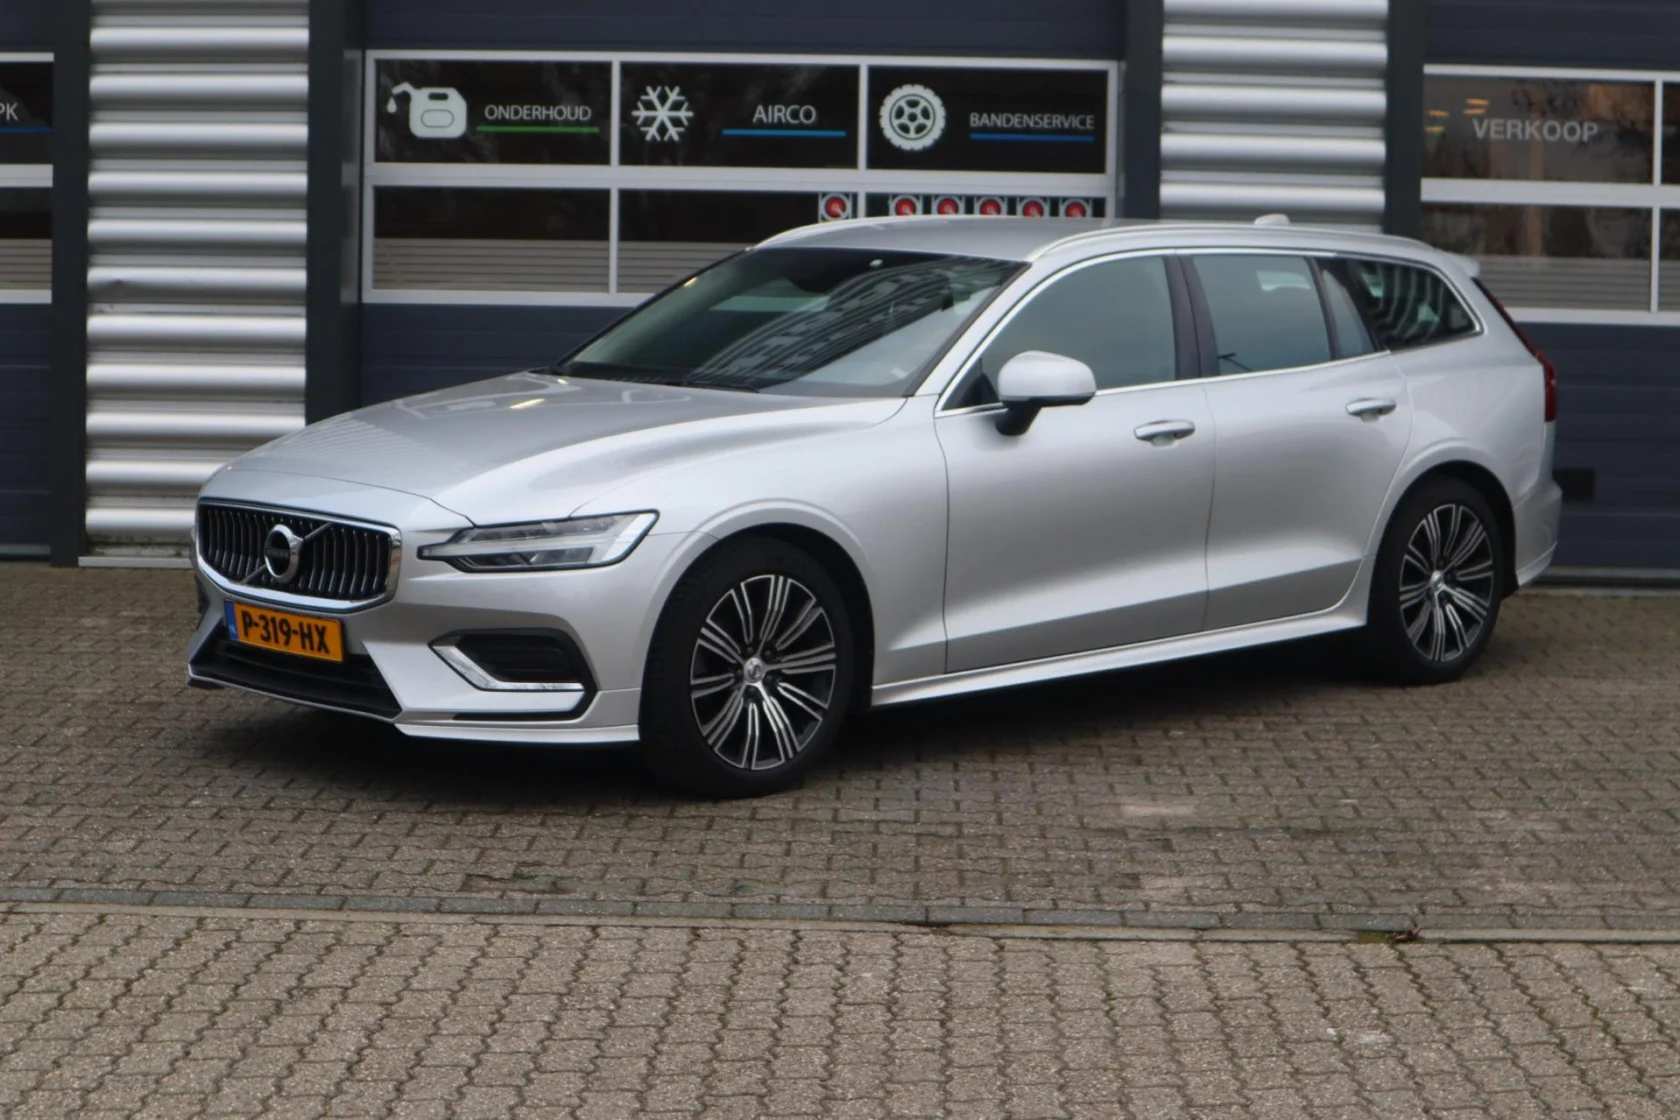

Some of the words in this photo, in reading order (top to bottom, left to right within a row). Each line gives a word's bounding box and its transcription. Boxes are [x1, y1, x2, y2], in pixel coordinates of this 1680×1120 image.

[484, 103, 592, 122] ONDERHOUD
[753, 104, 817, 125] AIRCO
[969, 112, 1094, 130] BANDENSERVICE
[1473, 118, 1599, 142] VERKOOP
[241, 611, 330, 655] P-319-HX
